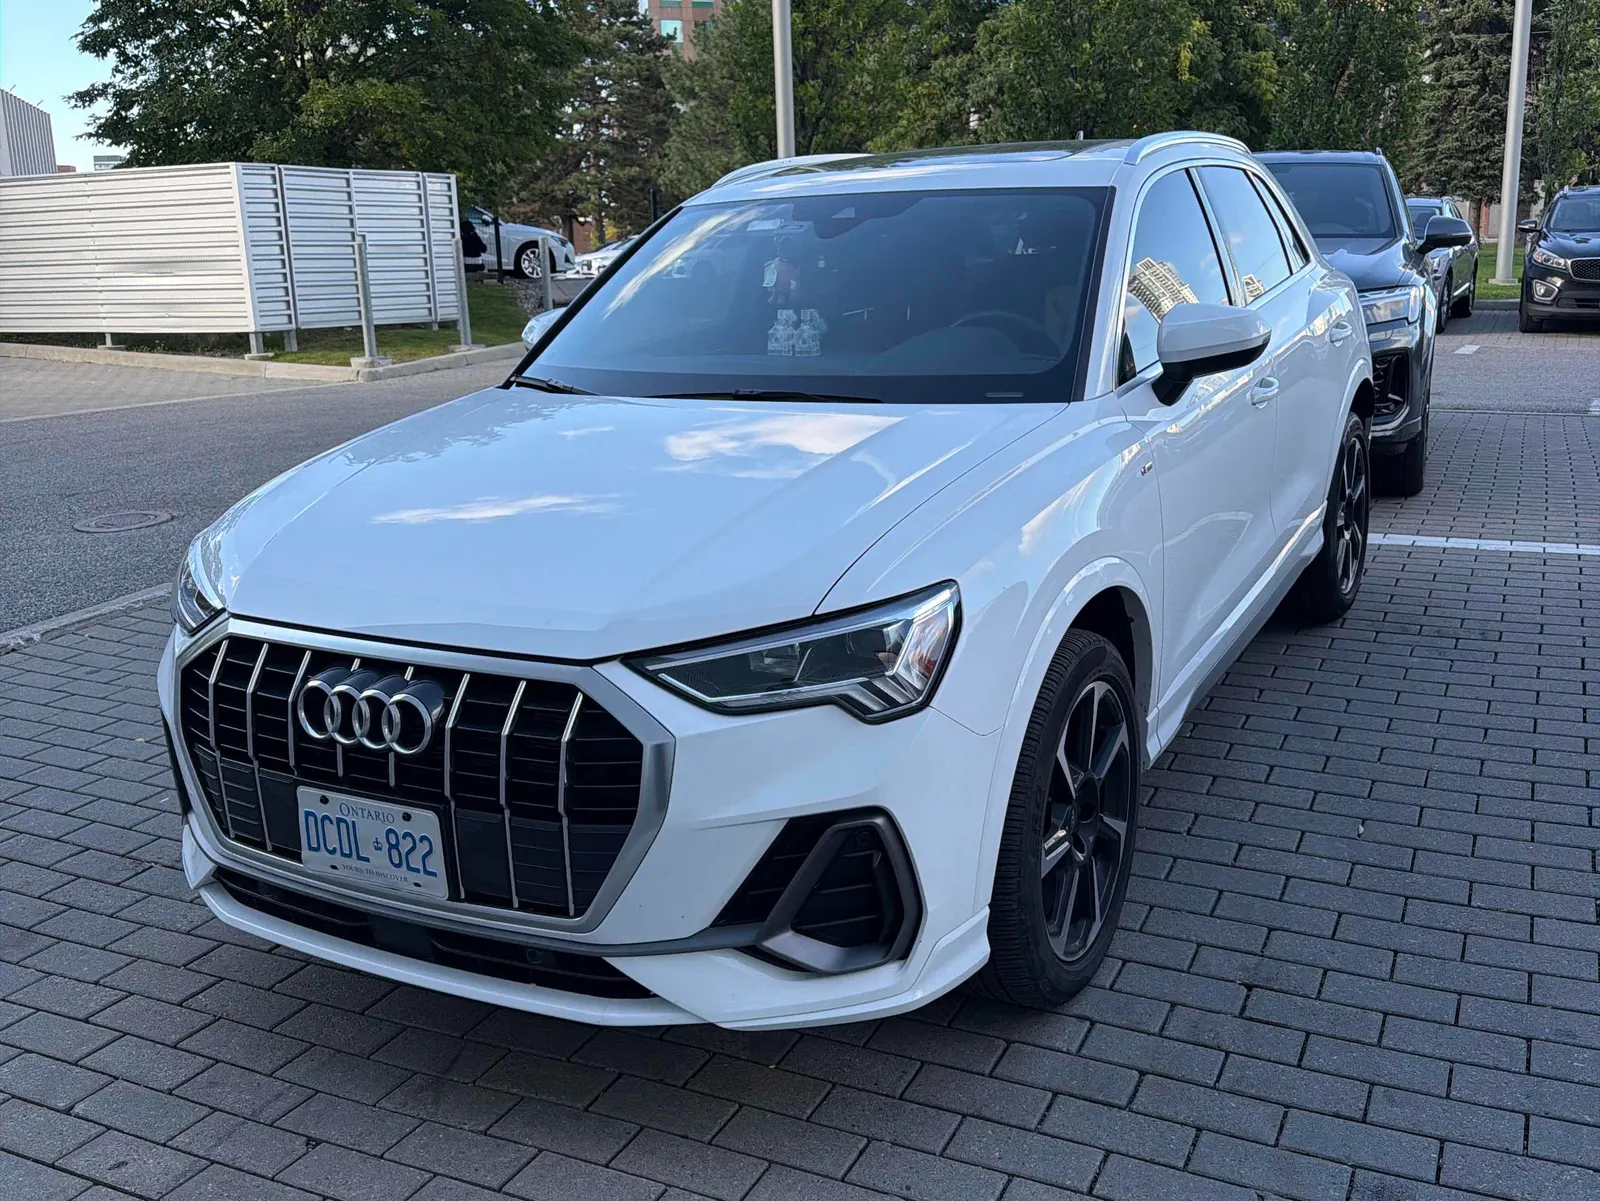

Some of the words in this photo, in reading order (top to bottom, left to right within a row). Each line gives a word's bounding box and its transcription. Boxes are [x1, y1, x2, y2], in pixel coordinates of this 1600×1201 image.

[339, 802, 395, 824] ONTARIO
[304, 810, 371, 863] DCDL
[385, 827, 438, 878] 822
[341, 863, 364, 875] YOURS
[365, 869, 375, 877] TO
[376, 870, 409, 884] DISCOVER
